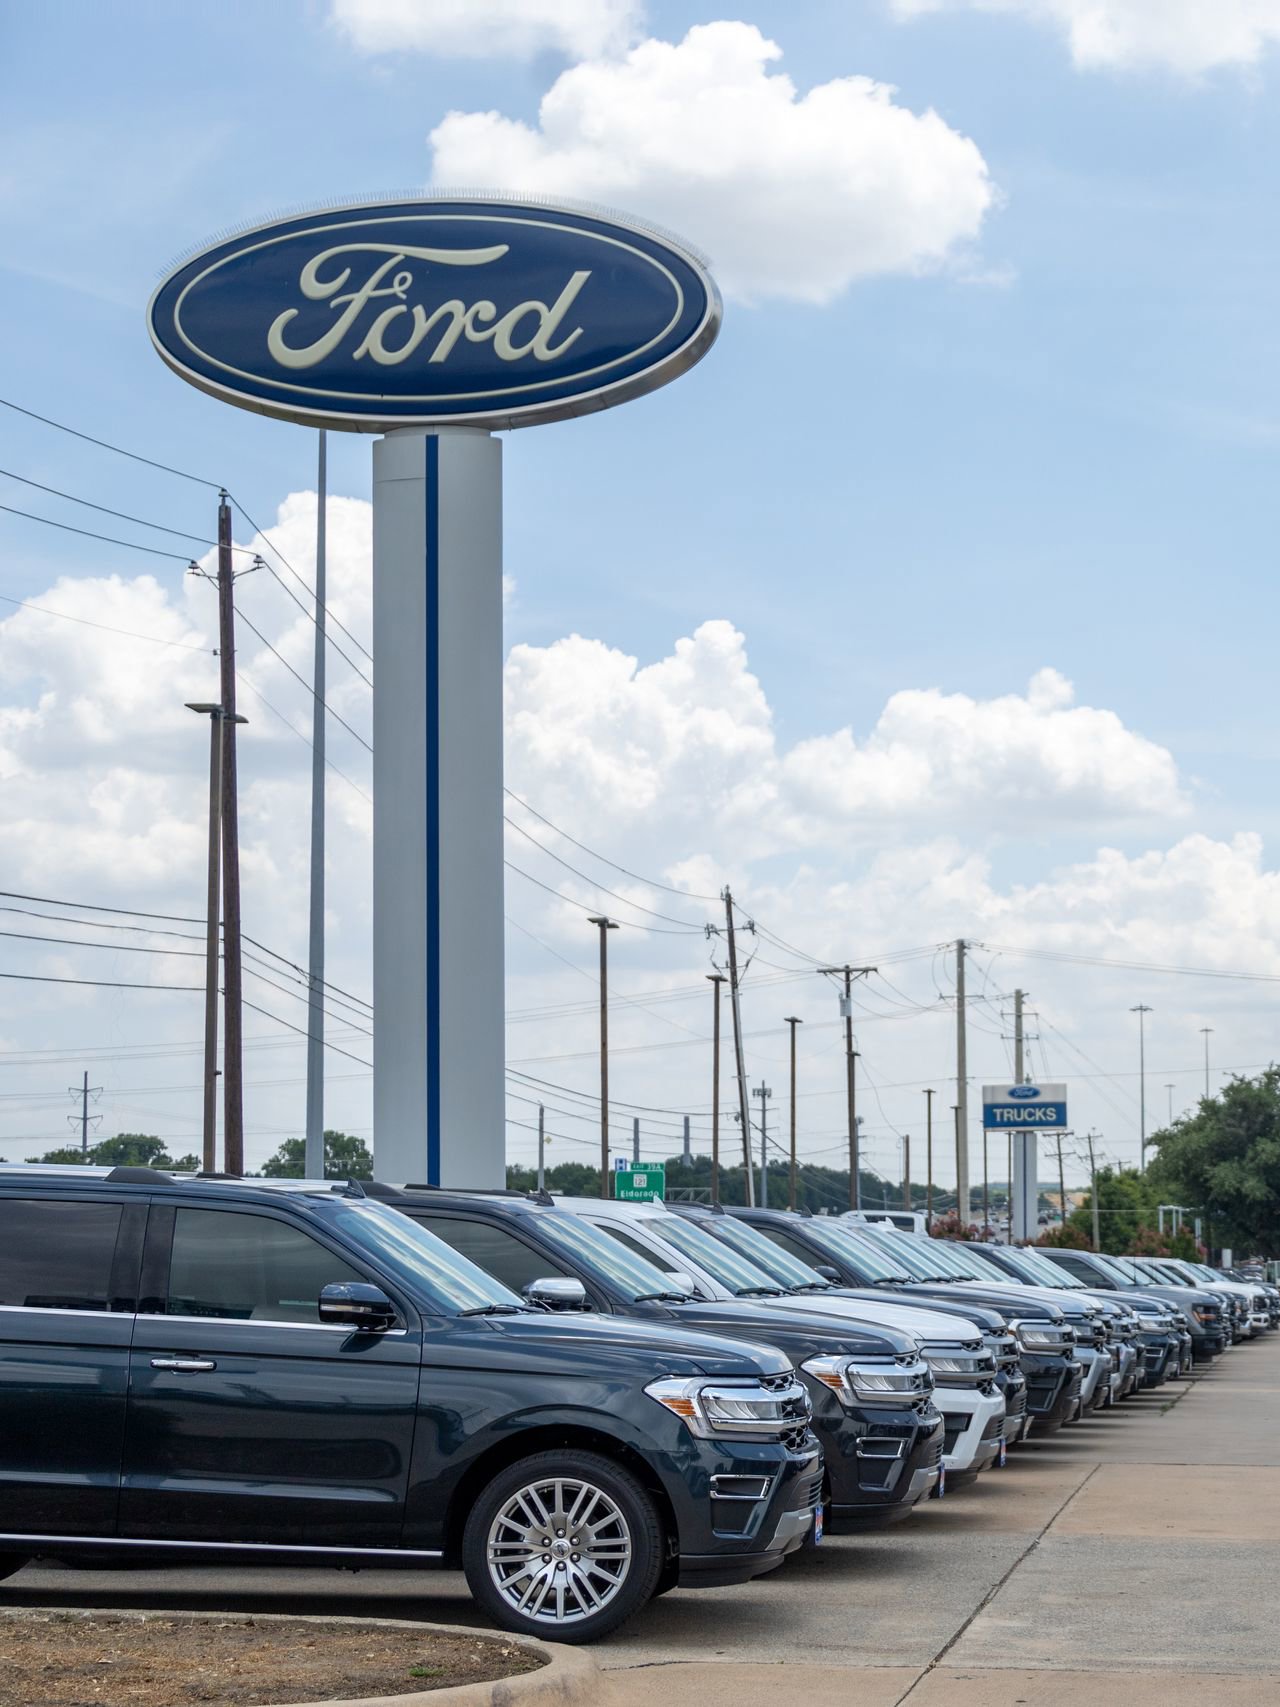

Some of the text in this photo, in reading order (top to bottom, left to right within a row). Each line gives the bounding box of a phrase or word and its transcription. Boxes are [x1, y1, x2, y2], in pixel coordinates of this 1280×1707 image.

[267, 243, 591, 369] Ford
[993, 1107, 1057, 1121] TRUCKS
[620, 1190, 660, 1198] Eldorado
